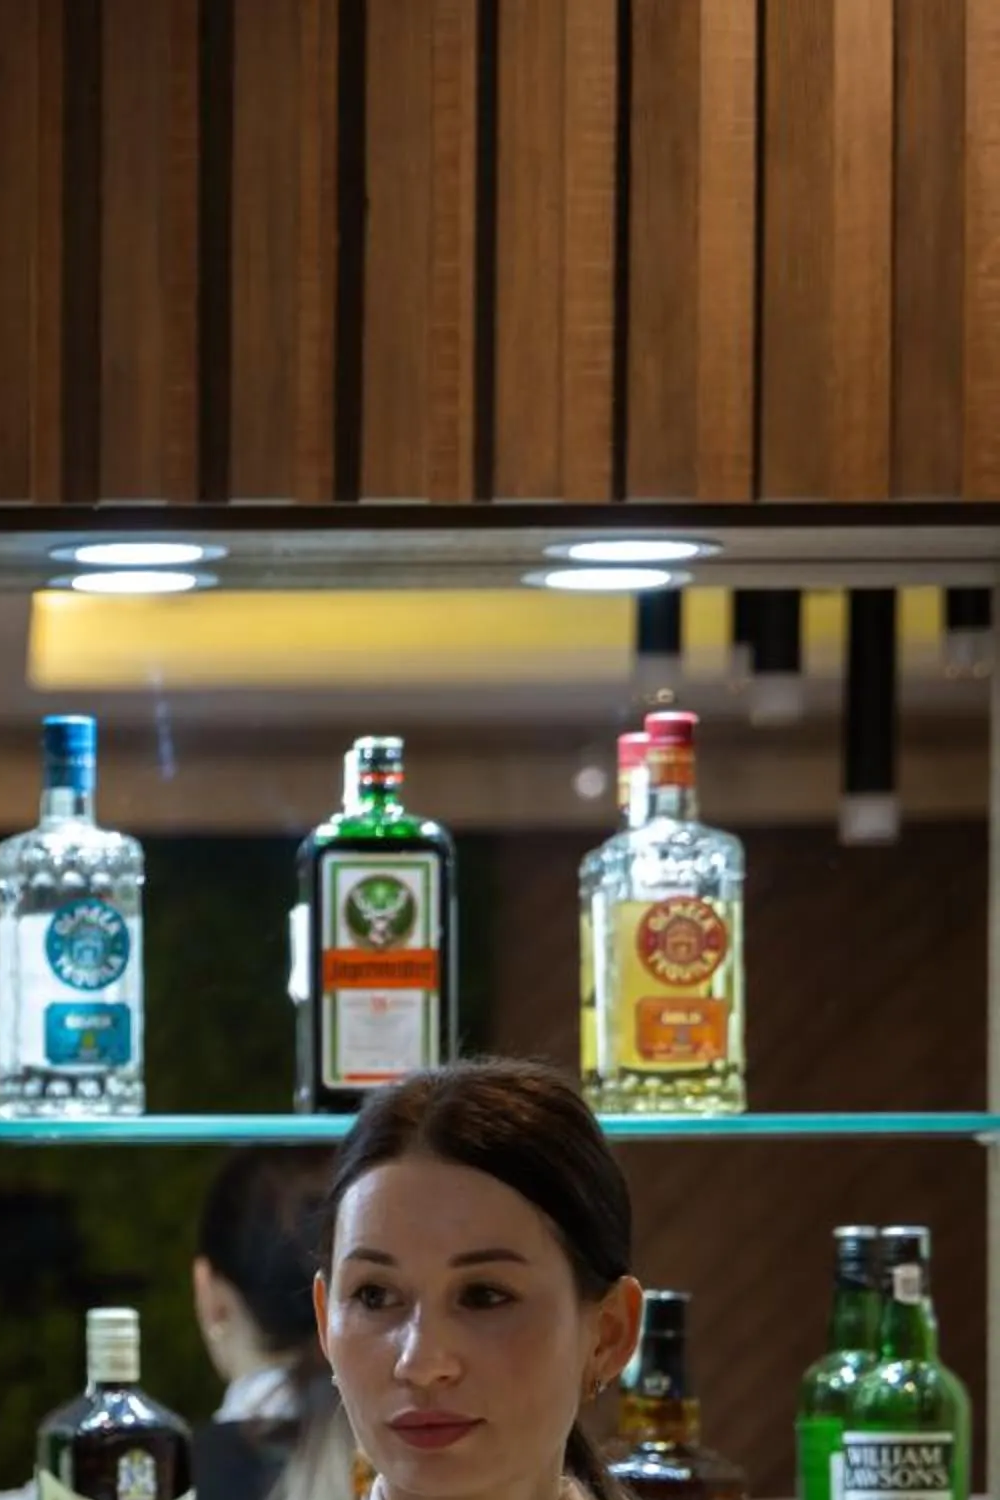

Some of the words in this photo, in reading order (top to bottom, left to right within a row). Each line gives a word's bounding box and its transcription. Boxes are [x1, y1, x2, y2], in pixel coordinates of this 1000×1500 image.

[54, 955, 124, 988] TEQUILA
[647, 949, 720, 982] TEQUILA
[847, 1446, 943, 1466] WILLIAM
